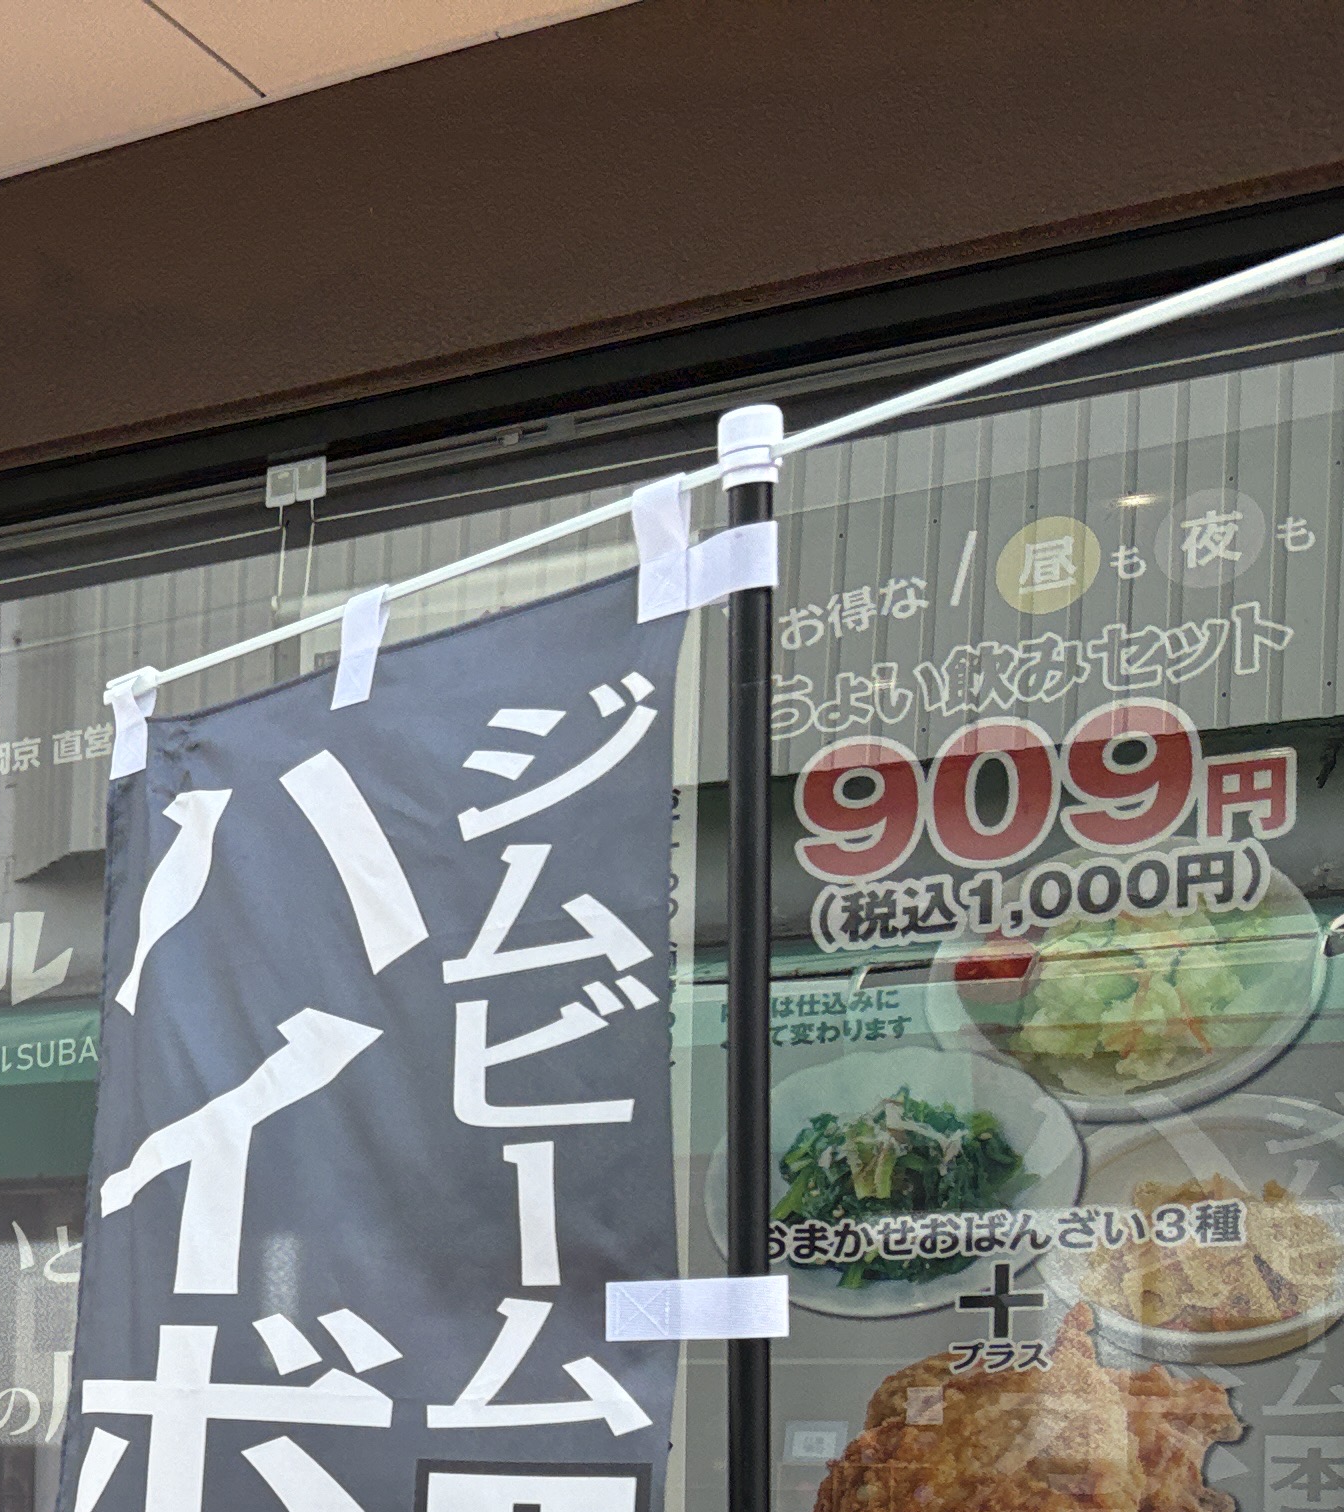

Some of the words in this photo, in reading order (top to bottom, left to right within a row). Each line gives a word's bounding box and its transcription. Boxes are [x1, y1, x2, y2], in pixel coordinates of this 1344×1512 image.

[778, 577, 928, 650] お得な
[52, 724, 113, 765] 直営
[796, 697, 1297, 884] 909円
[427, 671, 659, 1436] ジムビーム
[949, 1339, 1054, 1375] プラス
